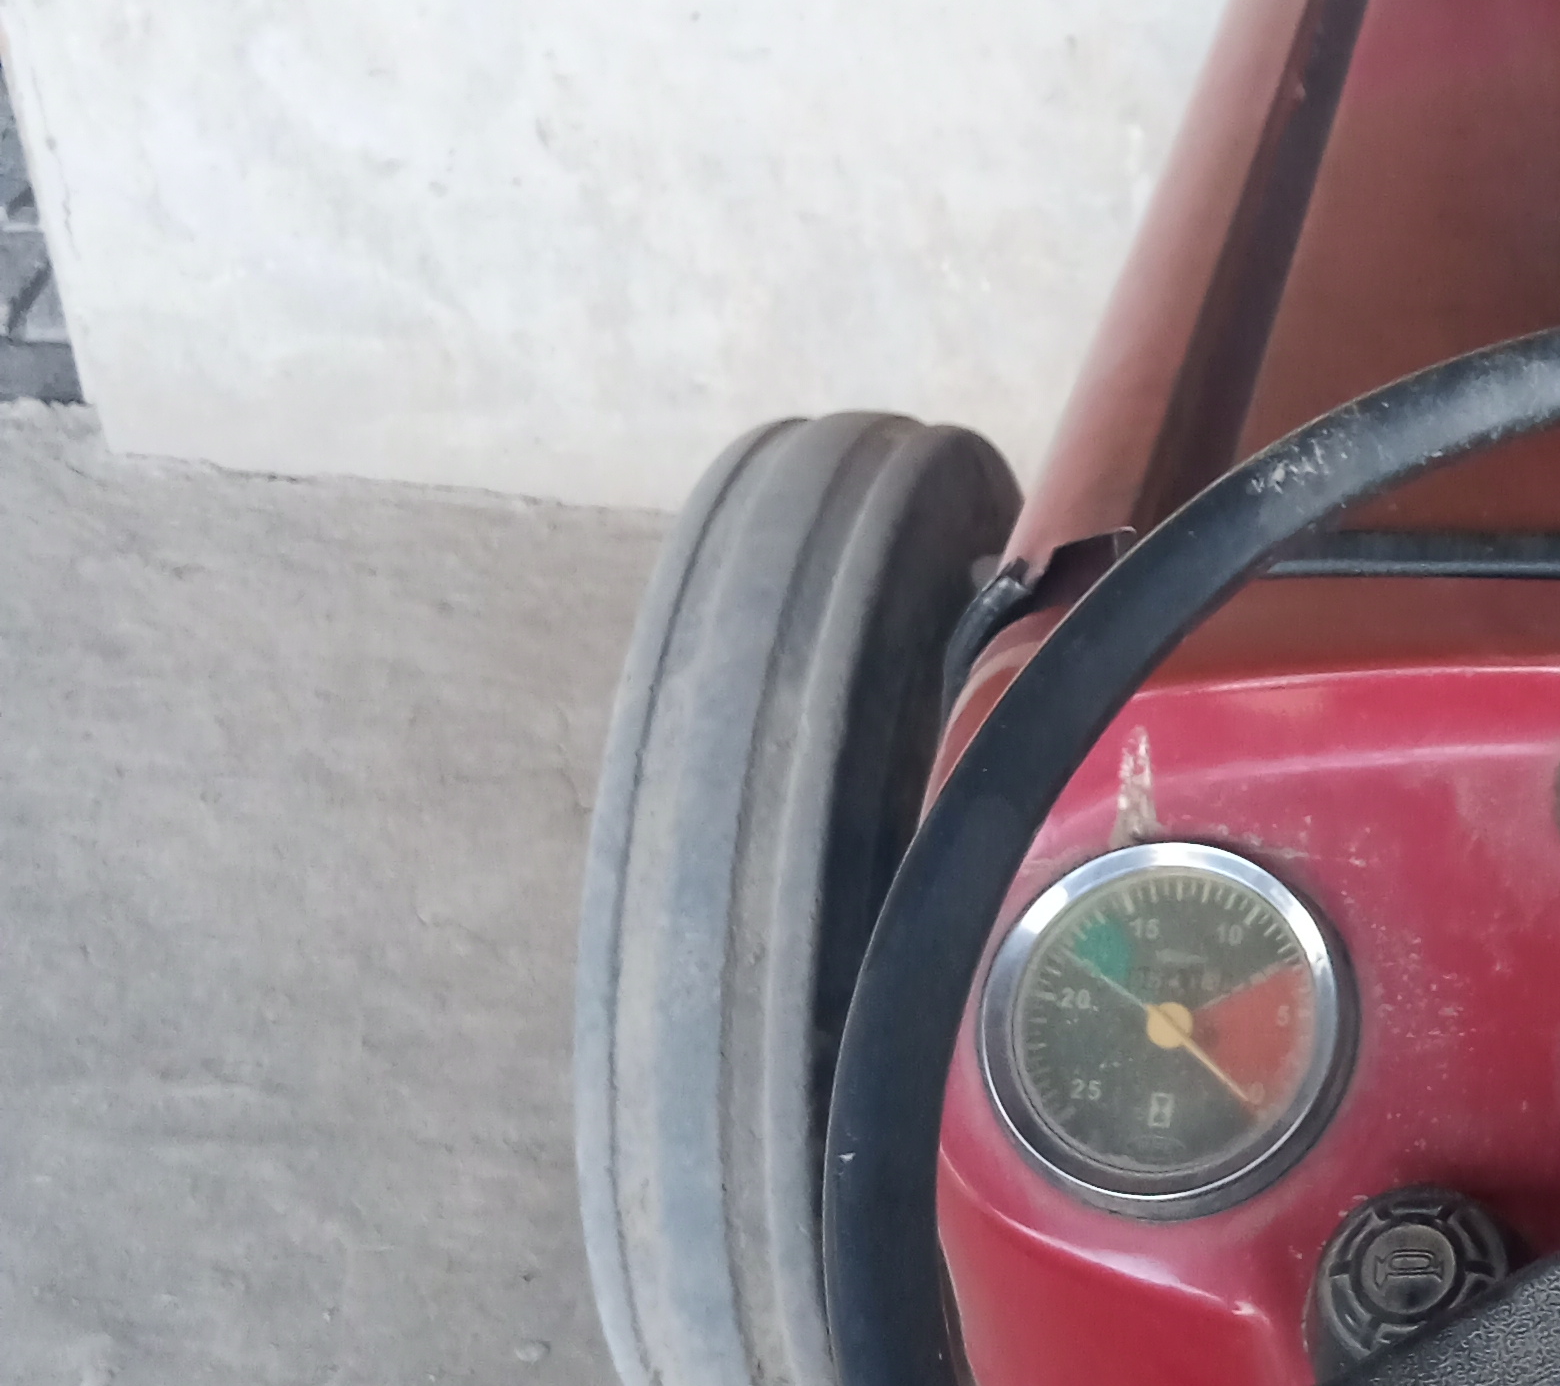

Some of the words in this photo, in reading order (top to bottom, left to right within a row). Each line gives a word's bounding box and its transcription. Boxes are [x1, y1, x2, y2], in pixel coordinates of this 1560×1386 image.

[1131, 917, 1160, 940] 15
[1215, 924, 1243, 947] 10
[1060, 987, 1091, 1010] 20
[1277, 1005, 1290, 1026] 5
[1069, 1078, 1102, 1101] 25
